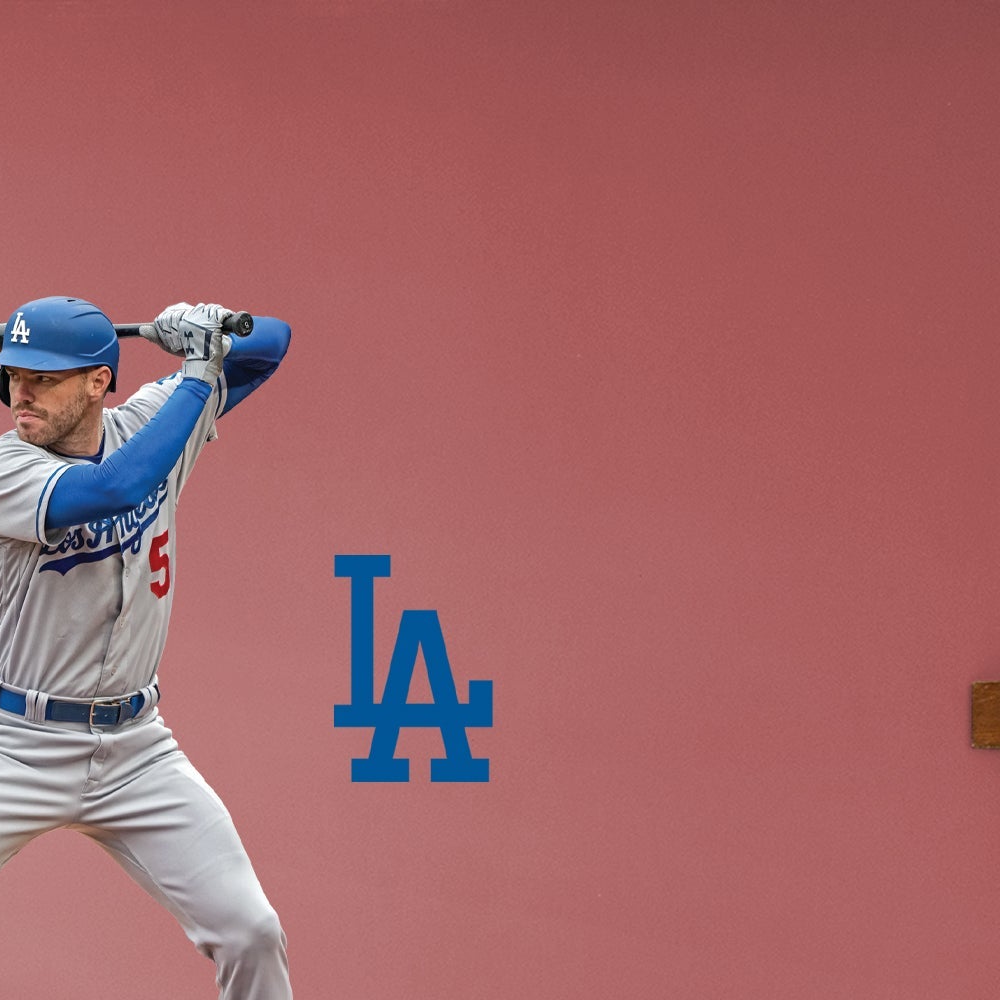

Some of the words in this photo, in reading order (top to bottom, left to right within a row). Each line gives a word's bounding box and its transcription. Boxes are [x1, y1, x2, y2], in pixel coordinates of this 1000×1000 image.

[10, 311, 30, 344] LA
[149, 529, 170, 599] 5
[334, 555, 493, 782] LA
